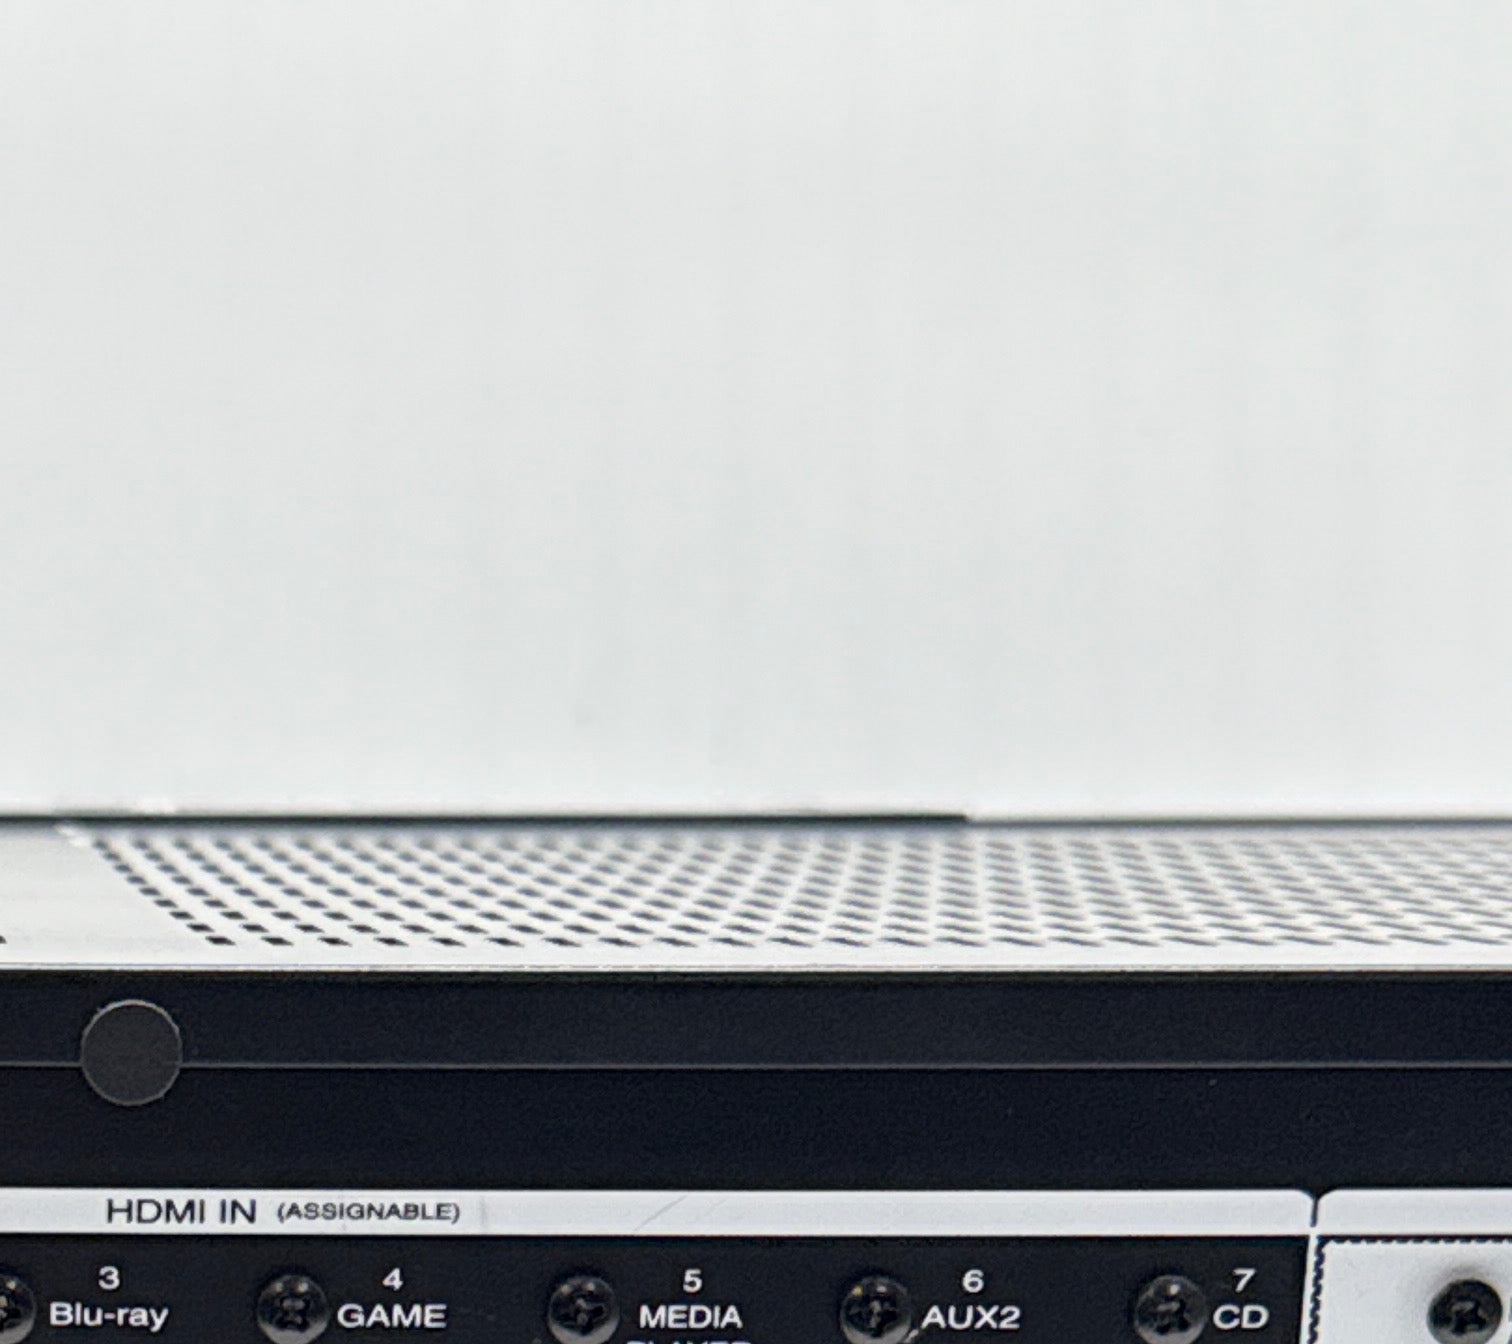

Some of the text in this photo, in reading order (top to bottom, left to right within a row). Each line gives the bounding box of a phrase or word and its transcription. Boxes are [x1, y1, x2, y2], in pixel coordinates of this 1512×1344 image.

[107, 1198, 461, 1225] HDMI IN (ASSIGNABLE)
[98, 1265, 120, 1290] 3
[382, 1267, 403, 1290] 4
[683, 1268, 703, 1293] 5
[962, 1269, 984, 1293] 6
[1233, 1268, 1256, 1292] 7
[49, 1301, 169, 1333] Blu-ray
[337, 1303, 447, 1329] GAME
[639, 1304, 743, 1329] MEDIA
[920, 1305, 1021, 1330] AUX2
[1212, 1304, 1269, 1330] CD
